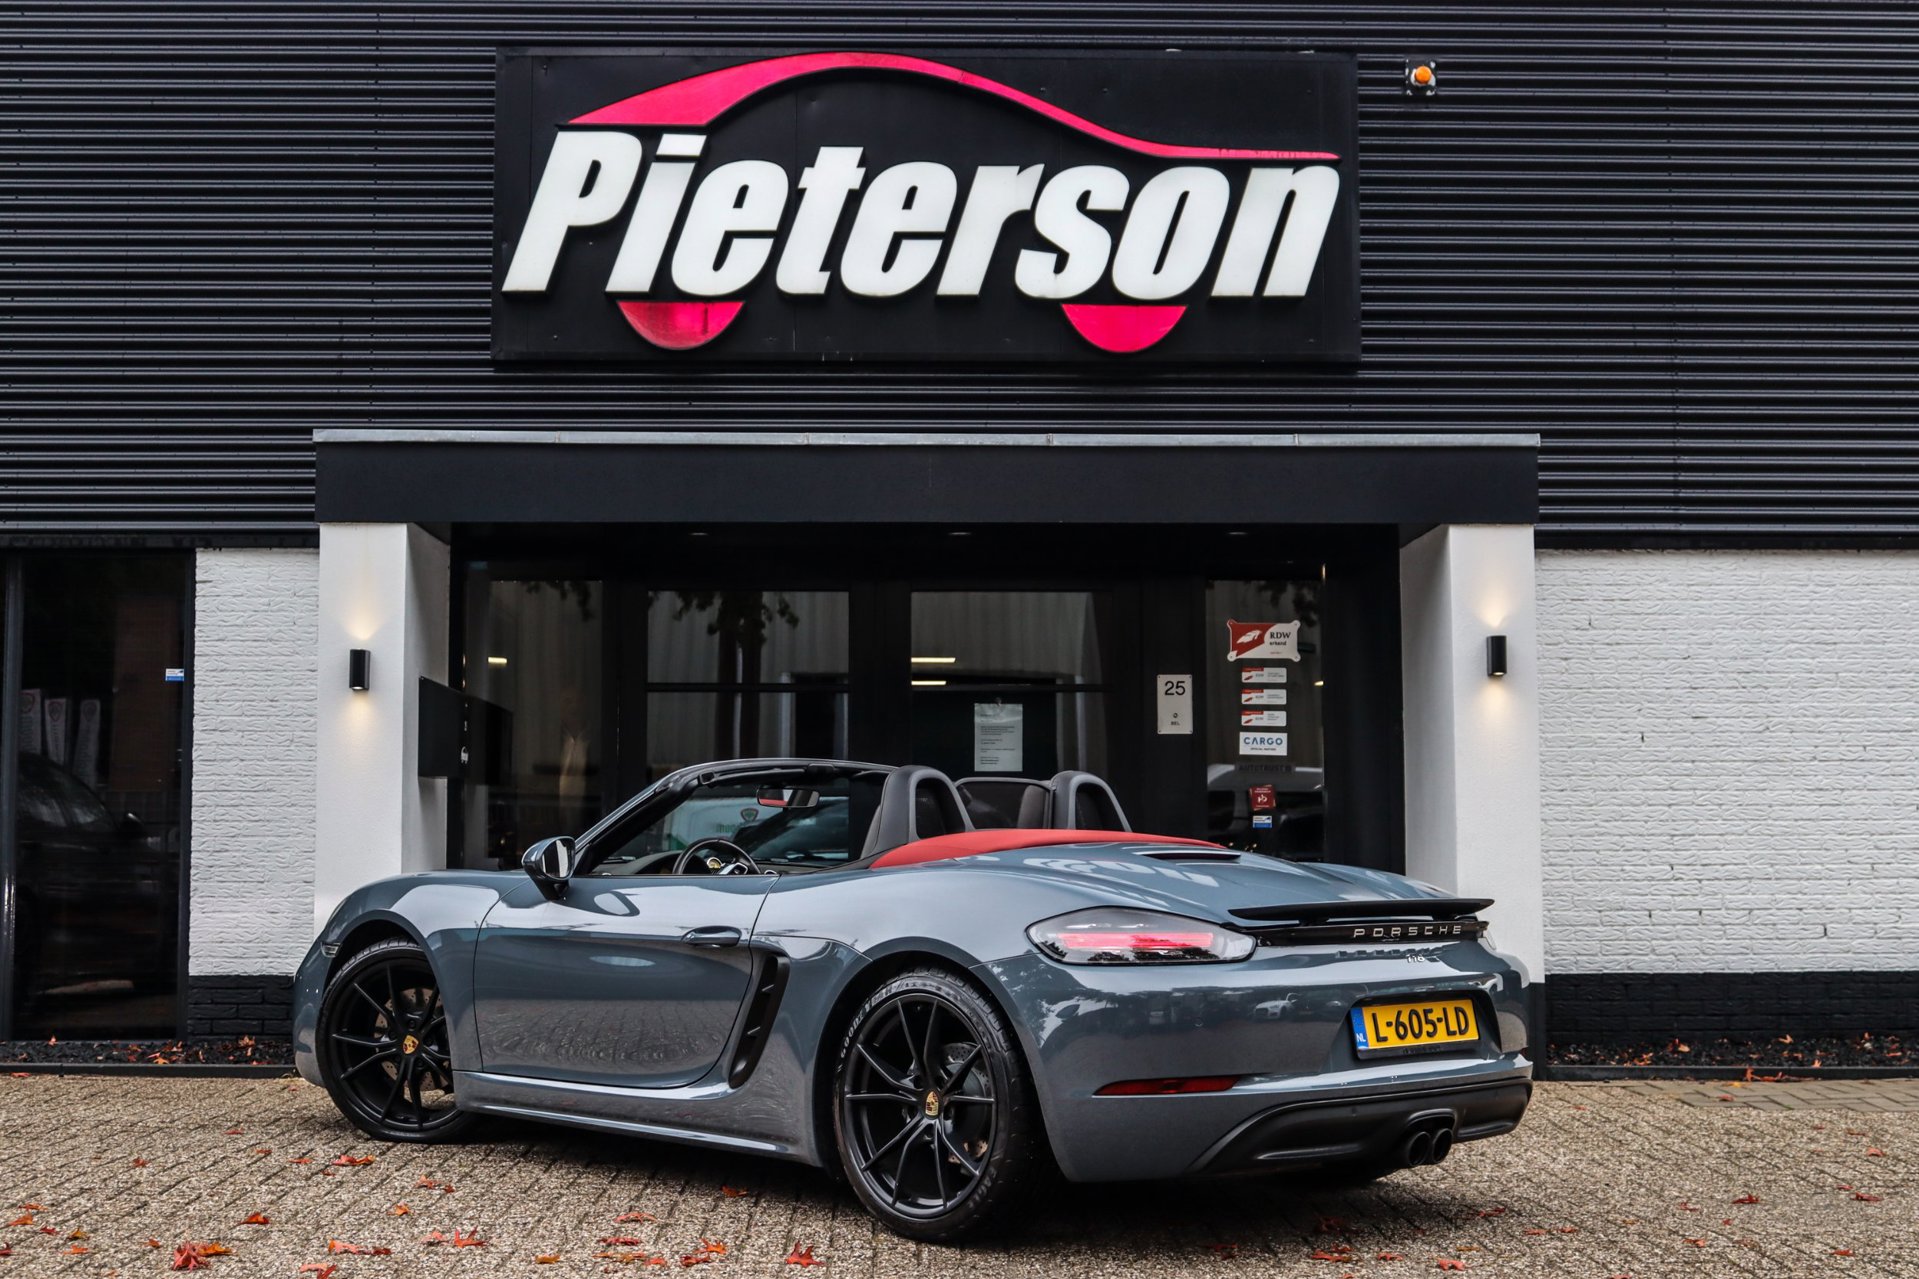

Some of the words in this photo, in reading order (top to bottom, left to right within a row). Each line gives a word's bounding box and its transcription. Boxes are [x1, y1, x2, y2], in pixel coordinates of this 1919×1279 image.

[502, 130, 1341, 299] Pieterson
[1269, 631, 1291, 639] RDW
[1164, 680, 1186, 696] 25
[1243, 736, 1283, 746] CARGO
[1353, 925, 1462, 938] PORSCHE
[1371, 1006, 1470, 1043] L-605-LD
[1356, 1032, 1366, 1043] NL
